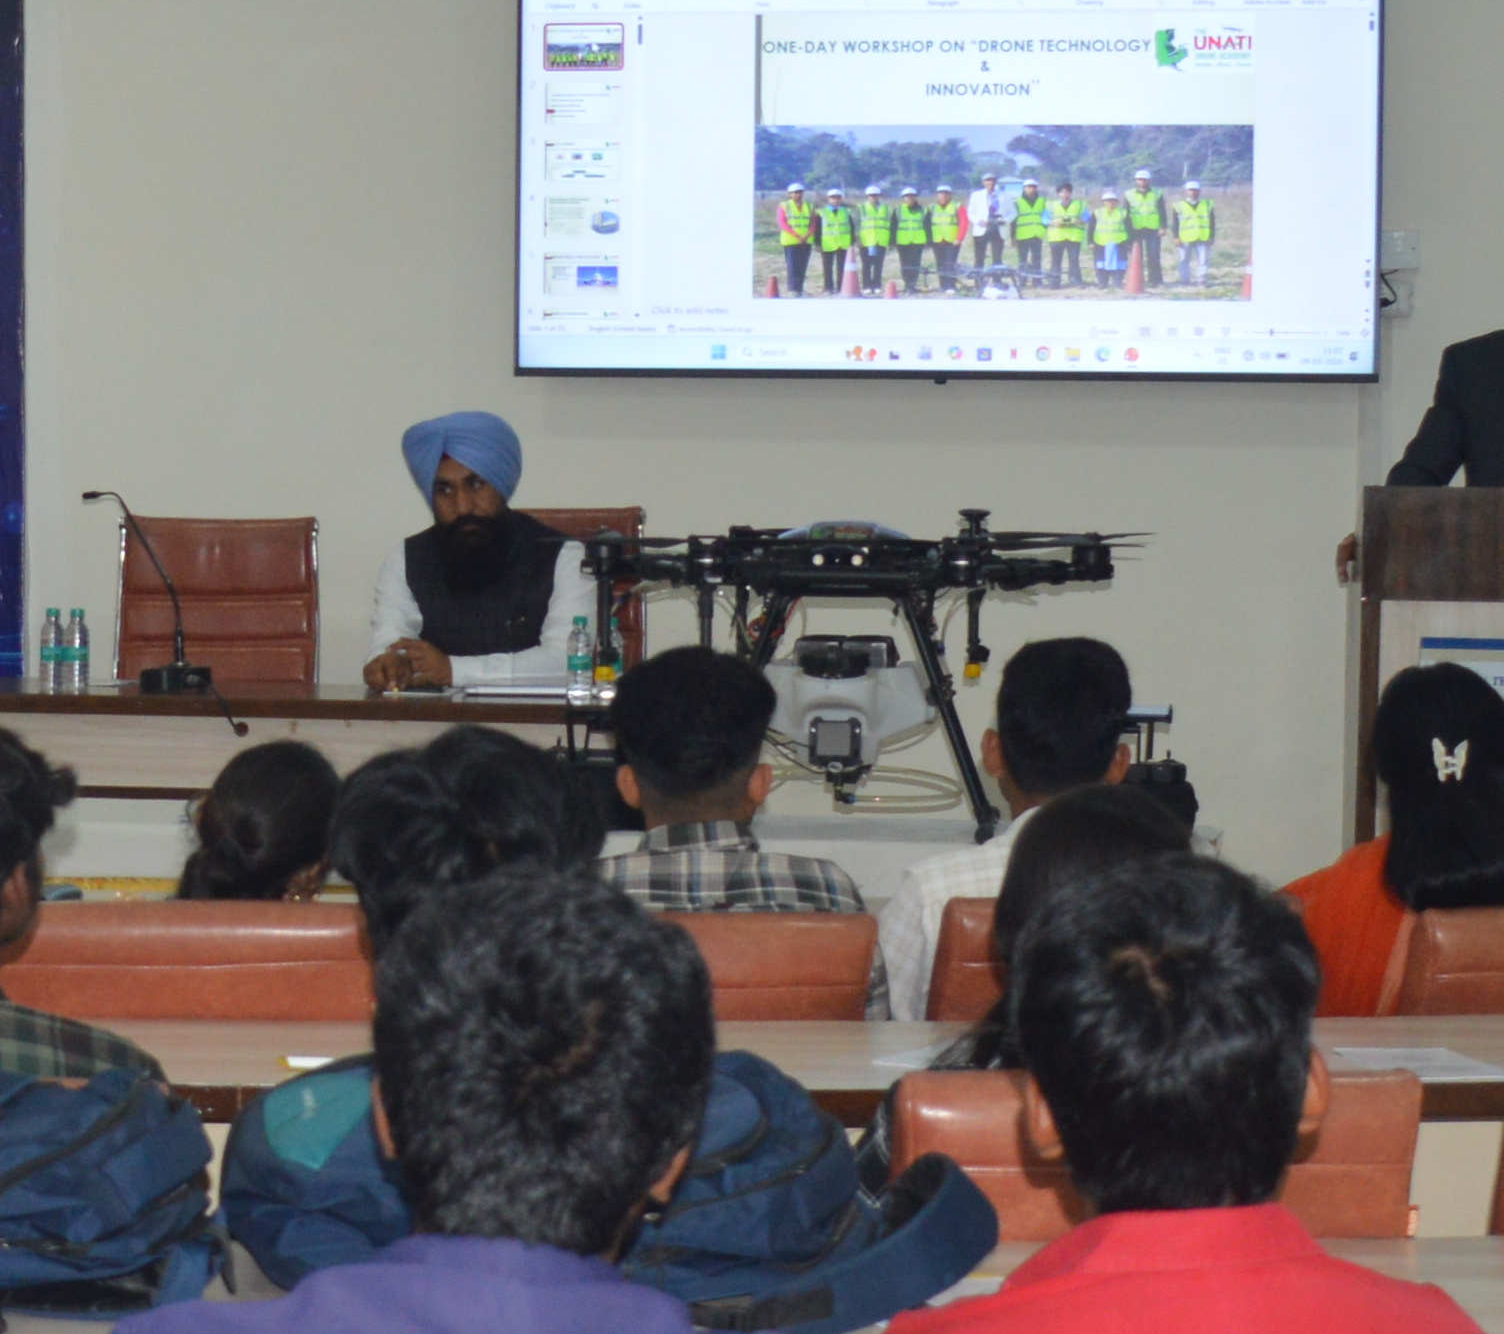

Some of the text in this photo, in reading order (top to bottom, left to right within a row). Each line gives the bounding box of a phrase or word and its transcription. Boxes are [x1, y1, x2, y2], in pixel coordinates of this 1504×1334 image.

[764, 41, 838, 54] ONE-DAY
[842, 40, 934, 53] WORKSHOP
[939, 40, 966, 53] ON
[1039, 39, 1151, 53] TECHNOLOGY
[1193, 34, 1253, 51] UNATI
[980, 61, 990, 72] &
